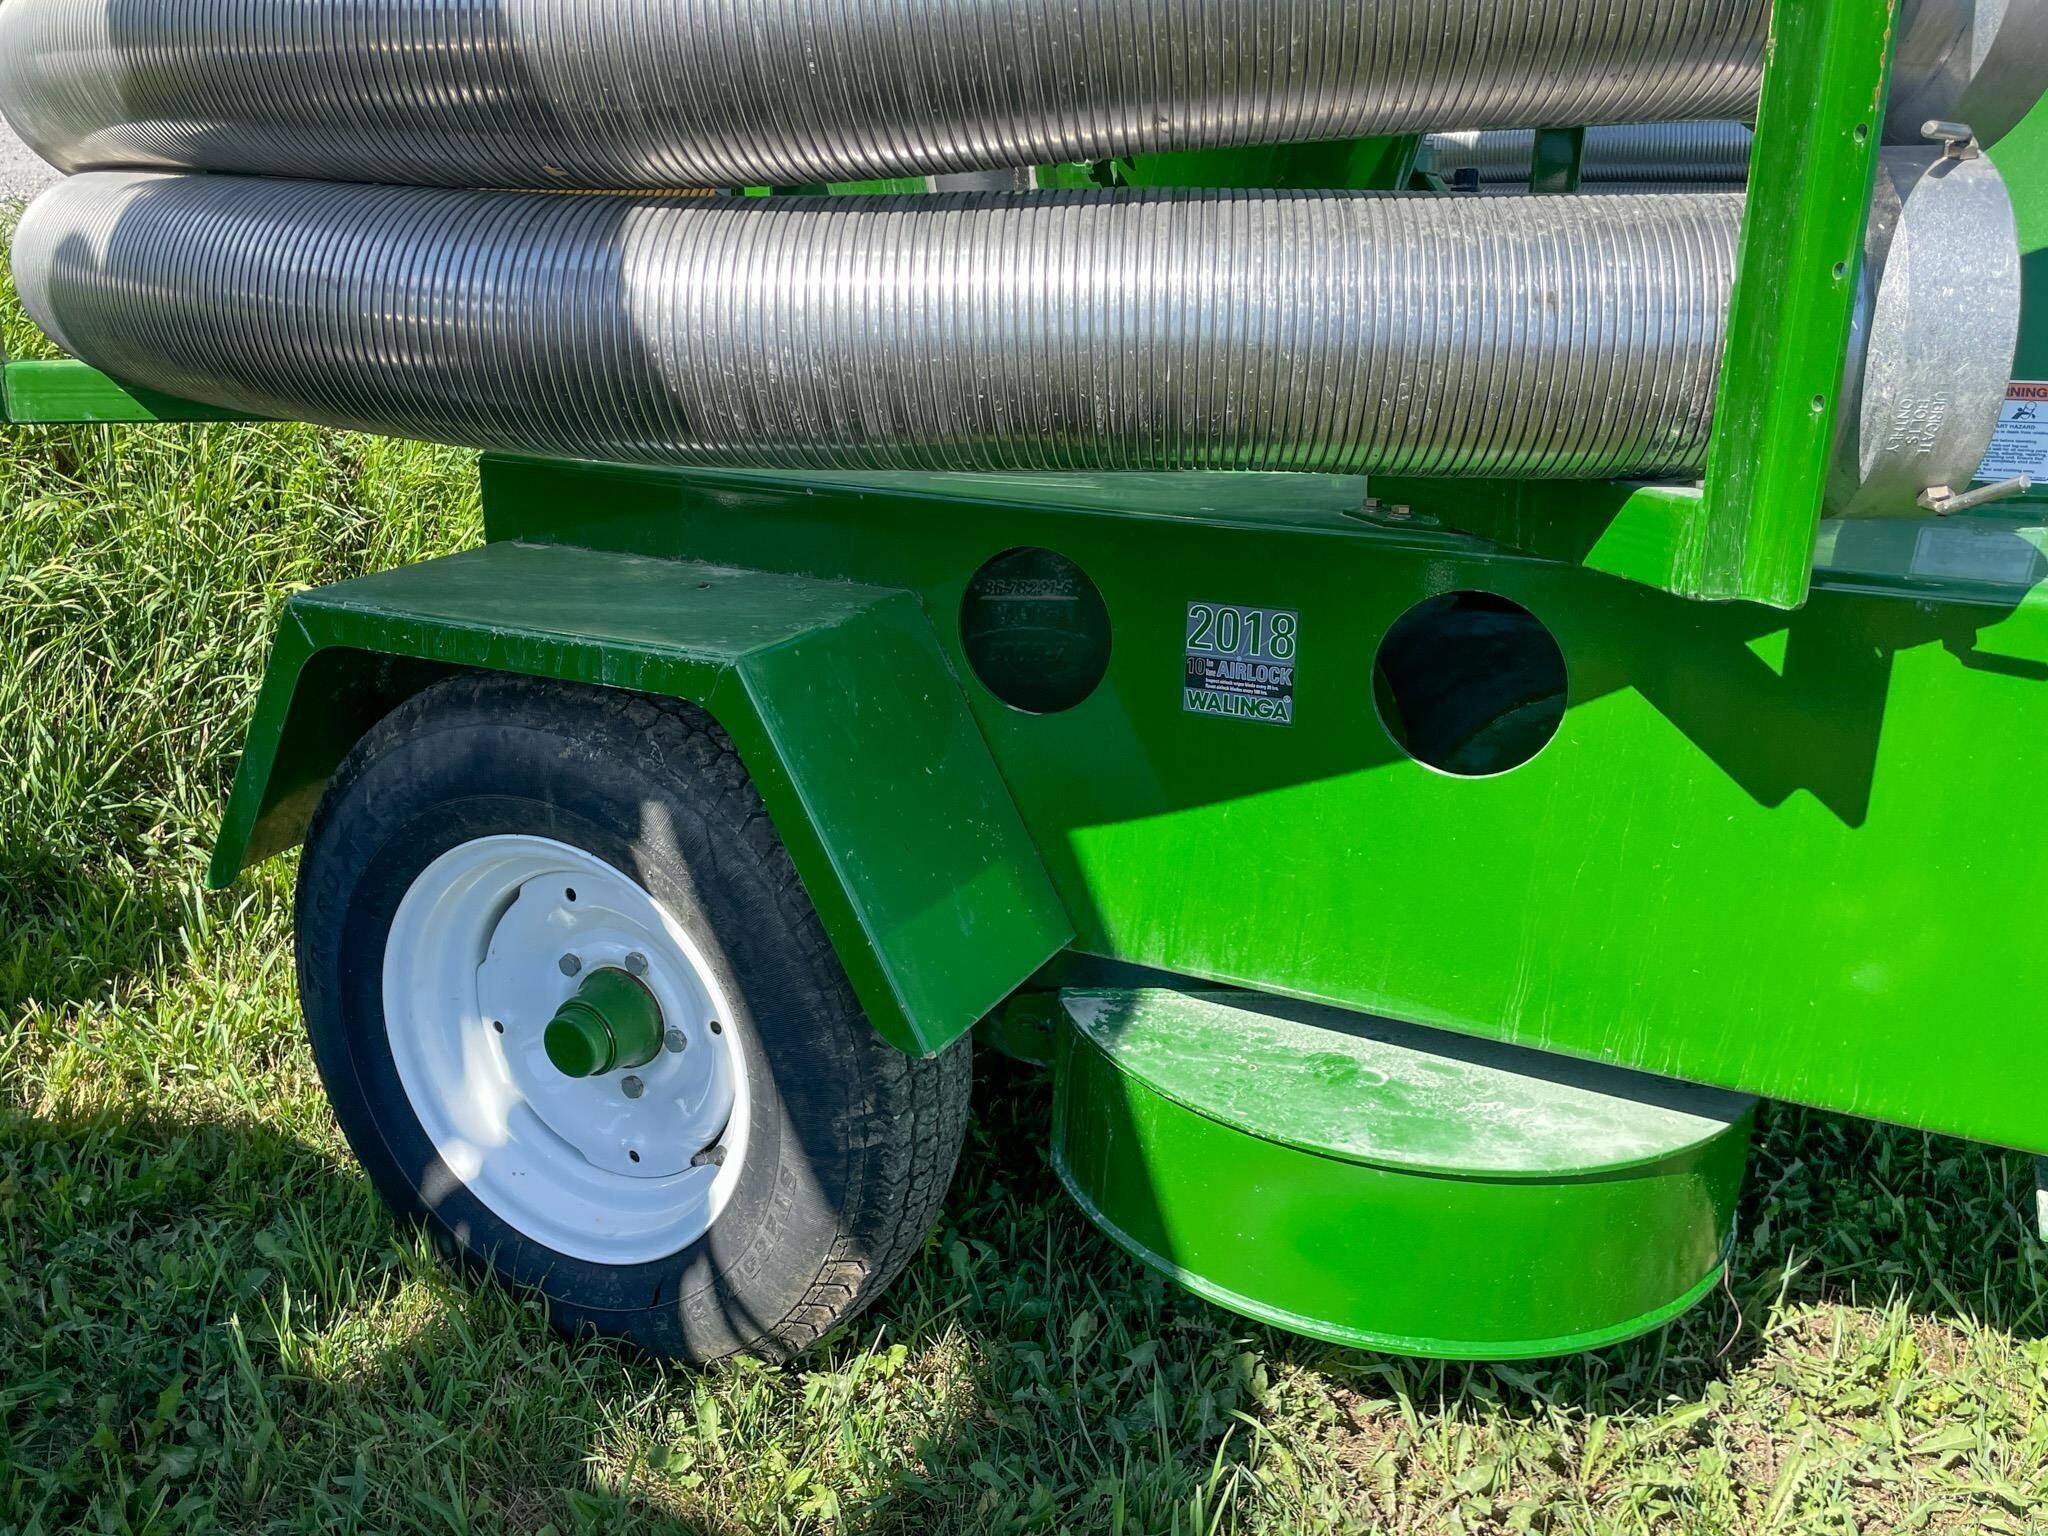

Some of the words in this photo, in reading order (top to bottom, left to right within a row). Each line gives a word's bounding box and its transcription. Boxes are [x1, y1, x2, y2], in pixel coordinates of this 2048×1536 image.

[2006, 387, 2048, 398] NING
[1187, 604, 1296, 660] 2018
[1187, 656, 1206, 675] 10
[1216, 660, 1293, 686] AIRLOCK
[1186, 688, 1290, 722] WALINGA
